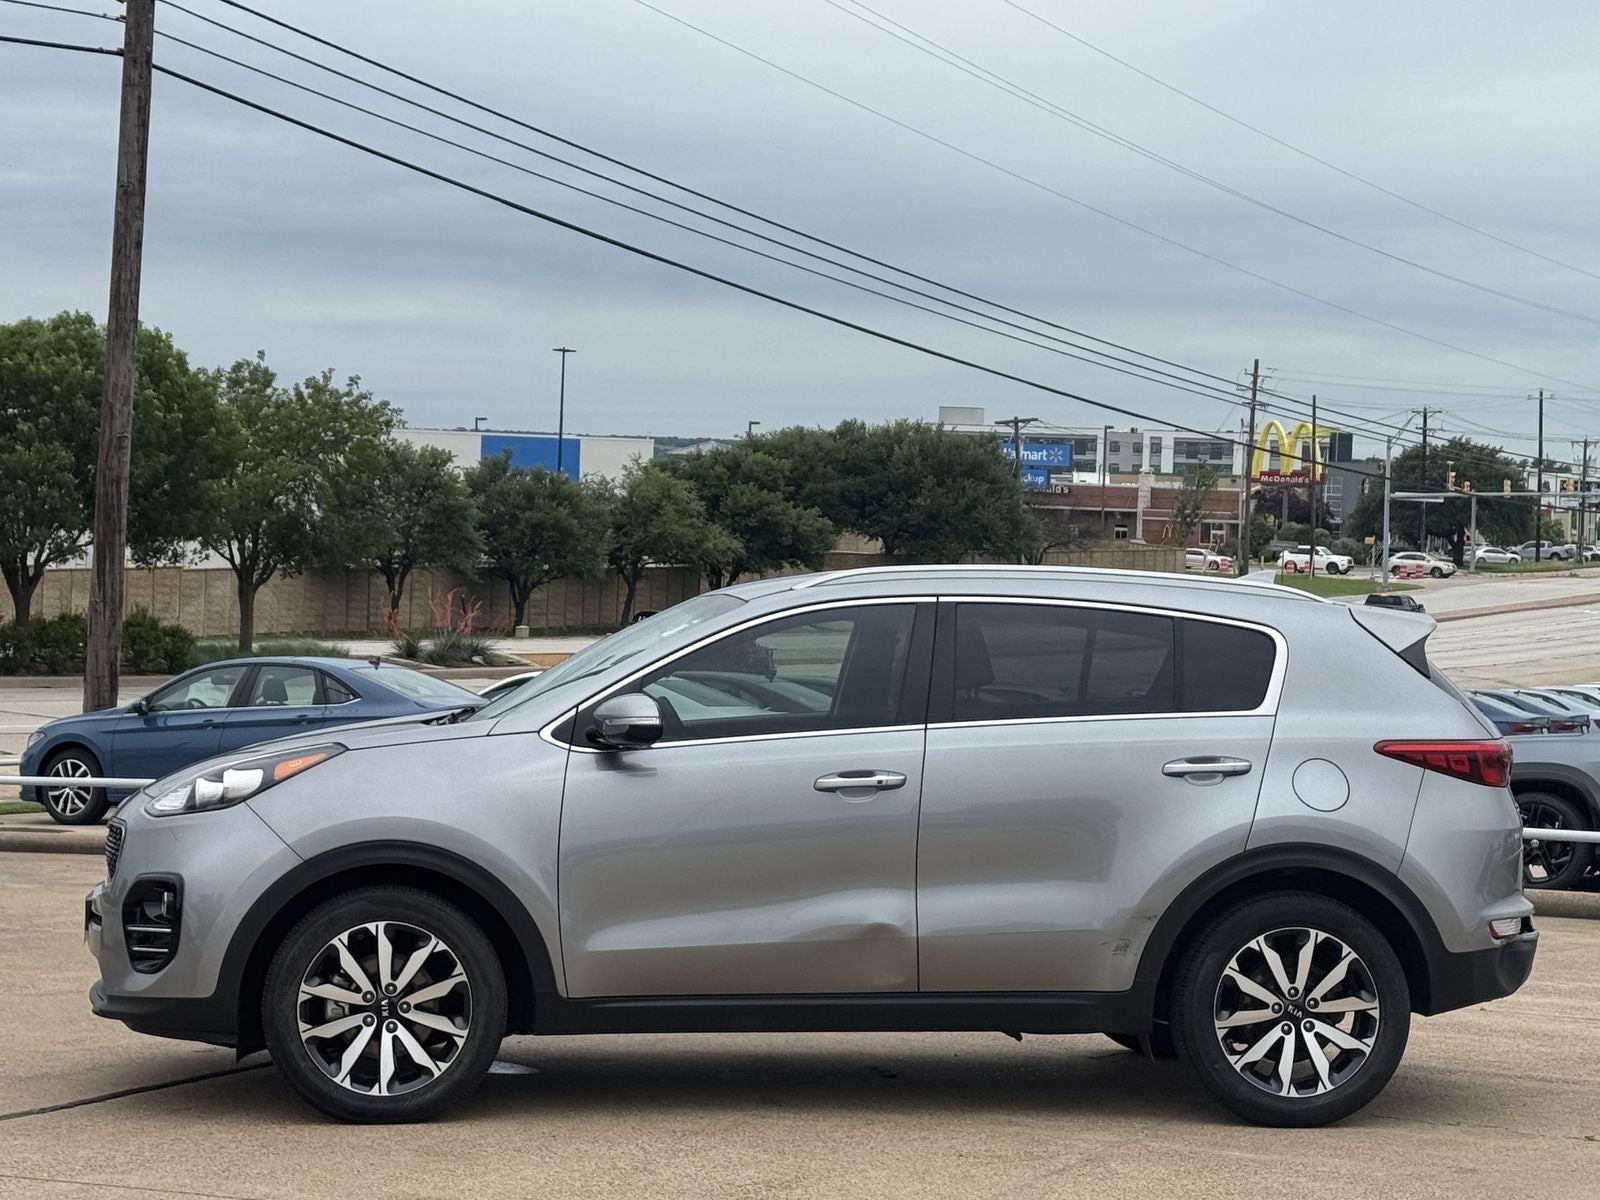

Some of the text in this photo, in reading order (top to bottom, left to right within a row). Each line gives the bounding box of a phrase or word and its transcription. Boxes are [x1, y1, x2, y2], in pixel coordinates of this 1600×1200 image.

[1259, 474, 1310, 484] McDonald's
[381, 999, 390, 1017] KIA
[1287, 1004, 1303, 1019] KIA
